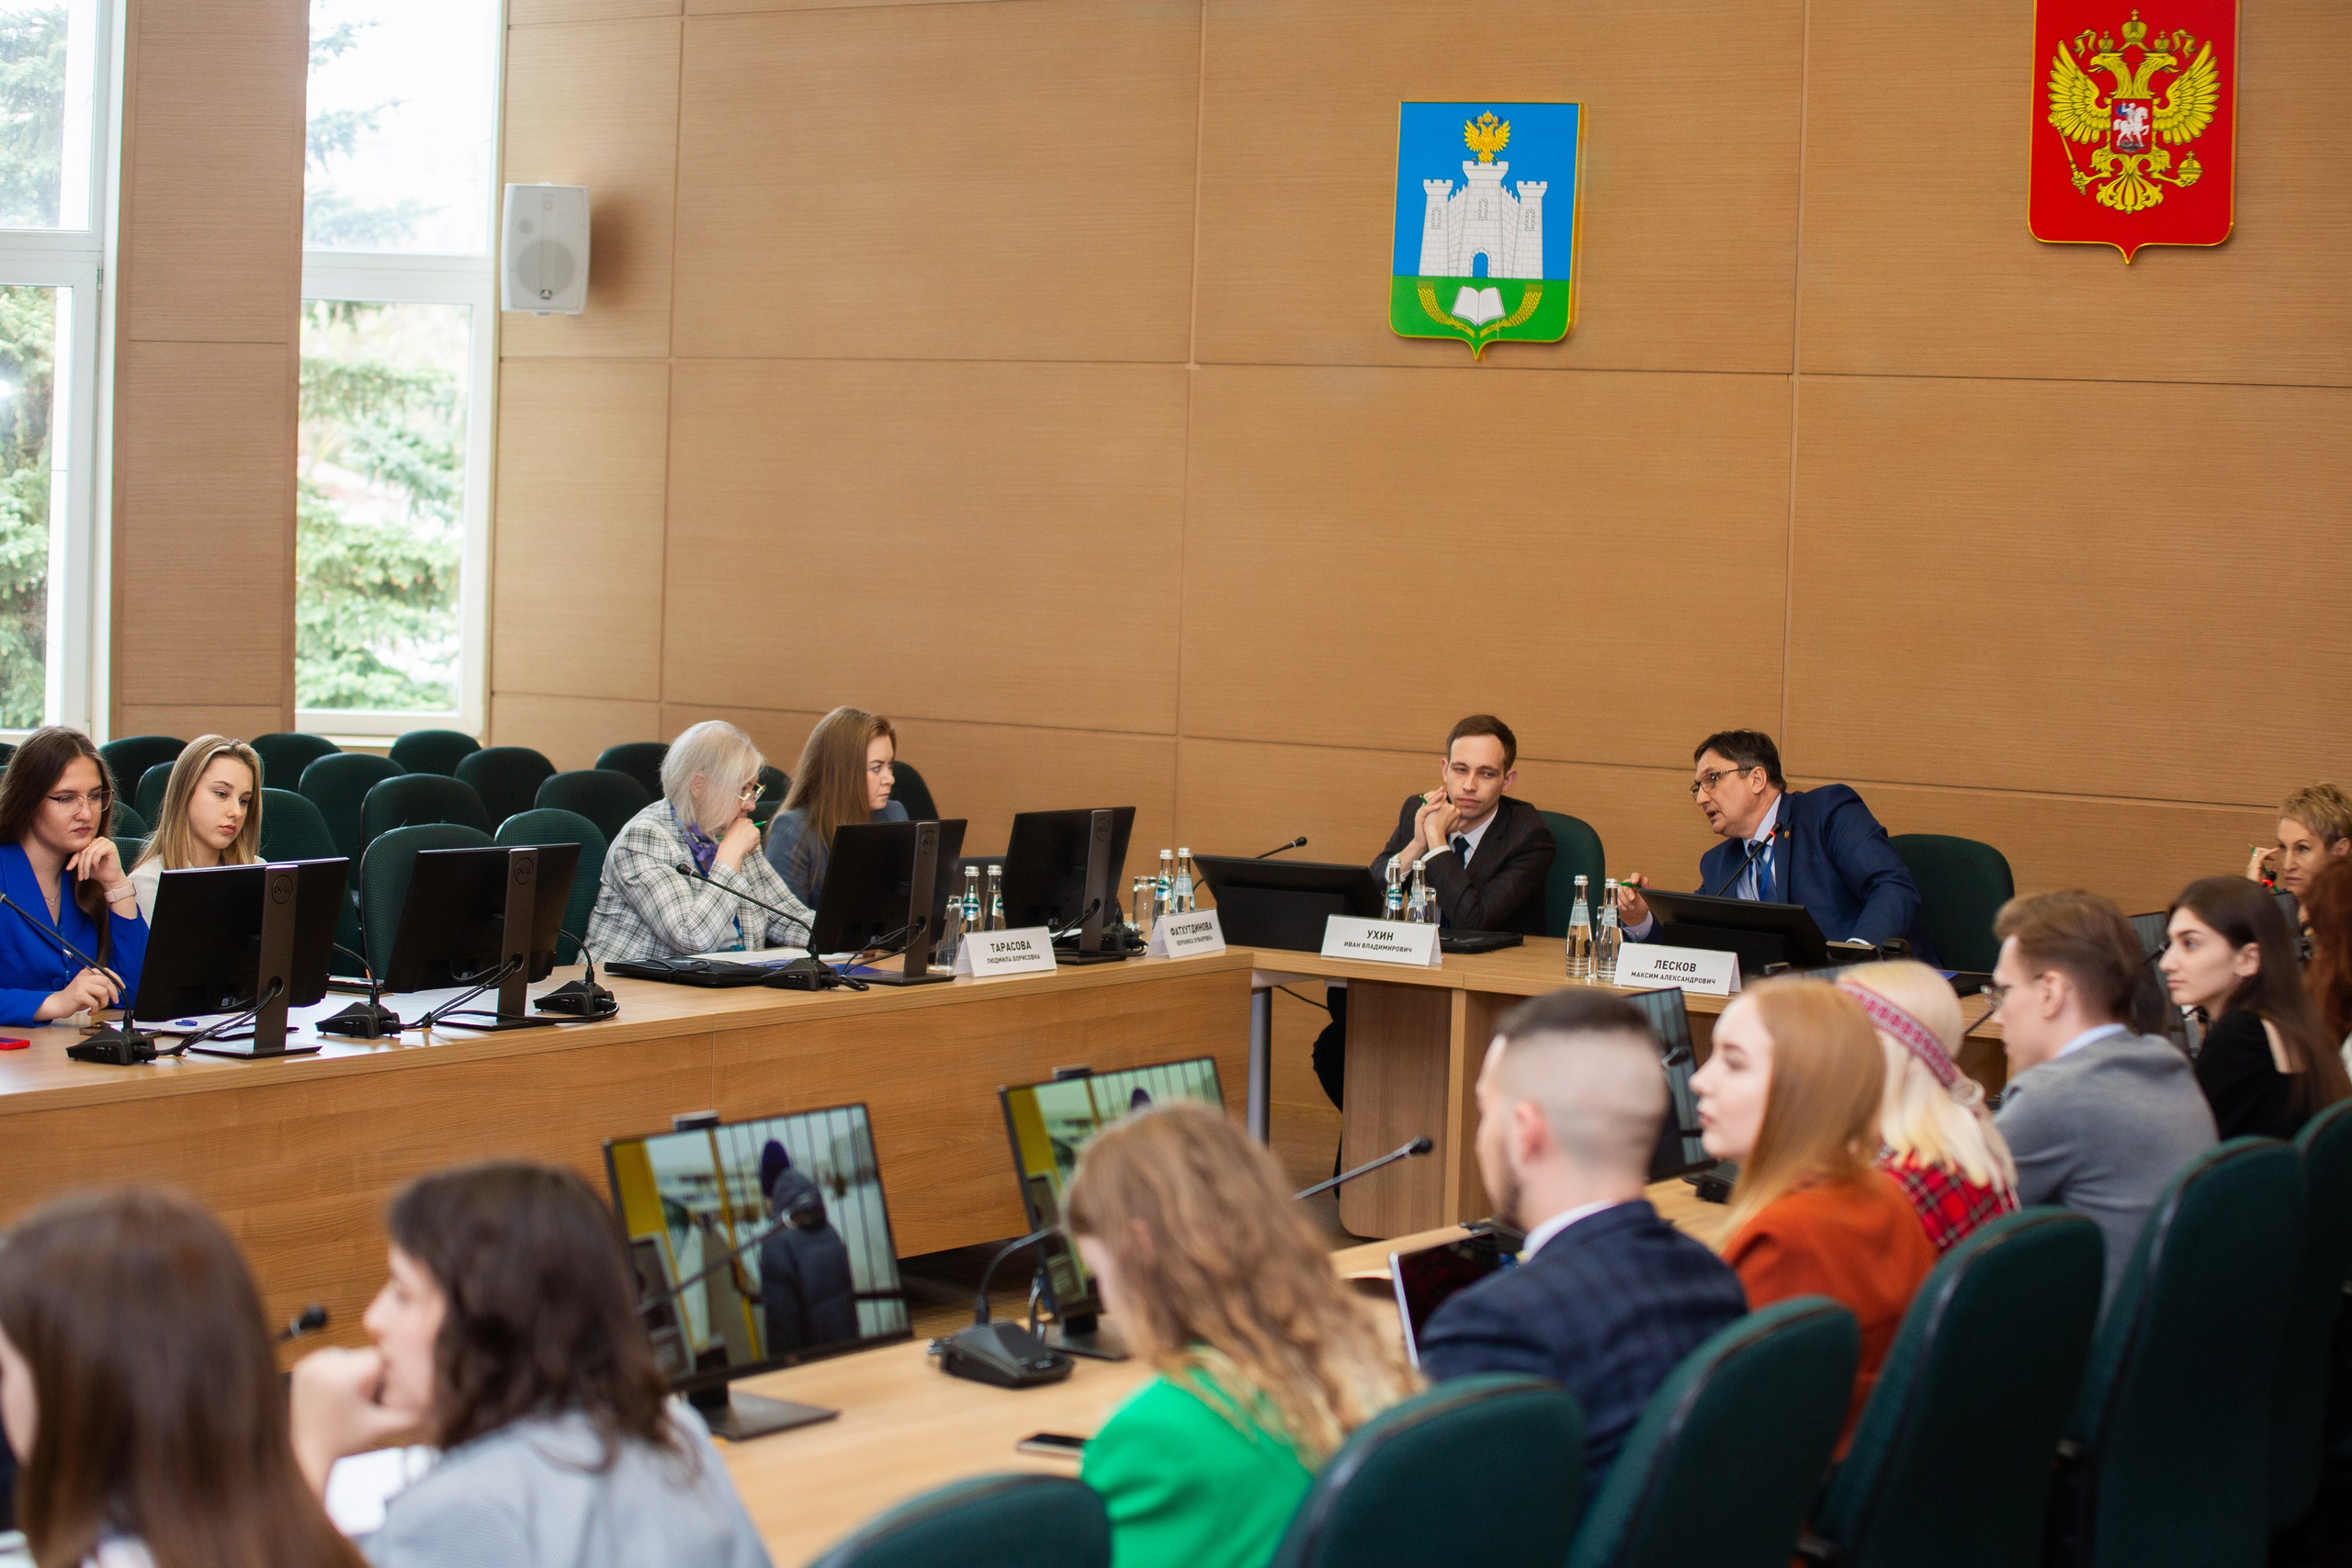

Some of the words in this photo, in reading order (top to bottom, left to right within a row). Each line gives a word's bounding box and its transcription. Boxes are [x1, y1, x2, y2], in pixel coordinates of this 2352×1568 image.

[1170, 921, 1213, 936] ФАТХУТДИНОВА
[1366, 930, 1395, 942] УХИН
[990, 941, 1033, 953] ТАРАСОВА
[1362, 942, 1413, 953] ВЛАДИМИРОВИЧ
[987, 956, 1012, 964] ЛЮДМИЛА
[1012, 953, 1041, 962] БОРИСОВНА
[1654, 959, 1697, 972] ЛЕСКОВ
[1631, 971, 1659, 979] МАКСИМ
[1659, 974, 1716, 985] АЛЕКСАНДРОВИЧ
